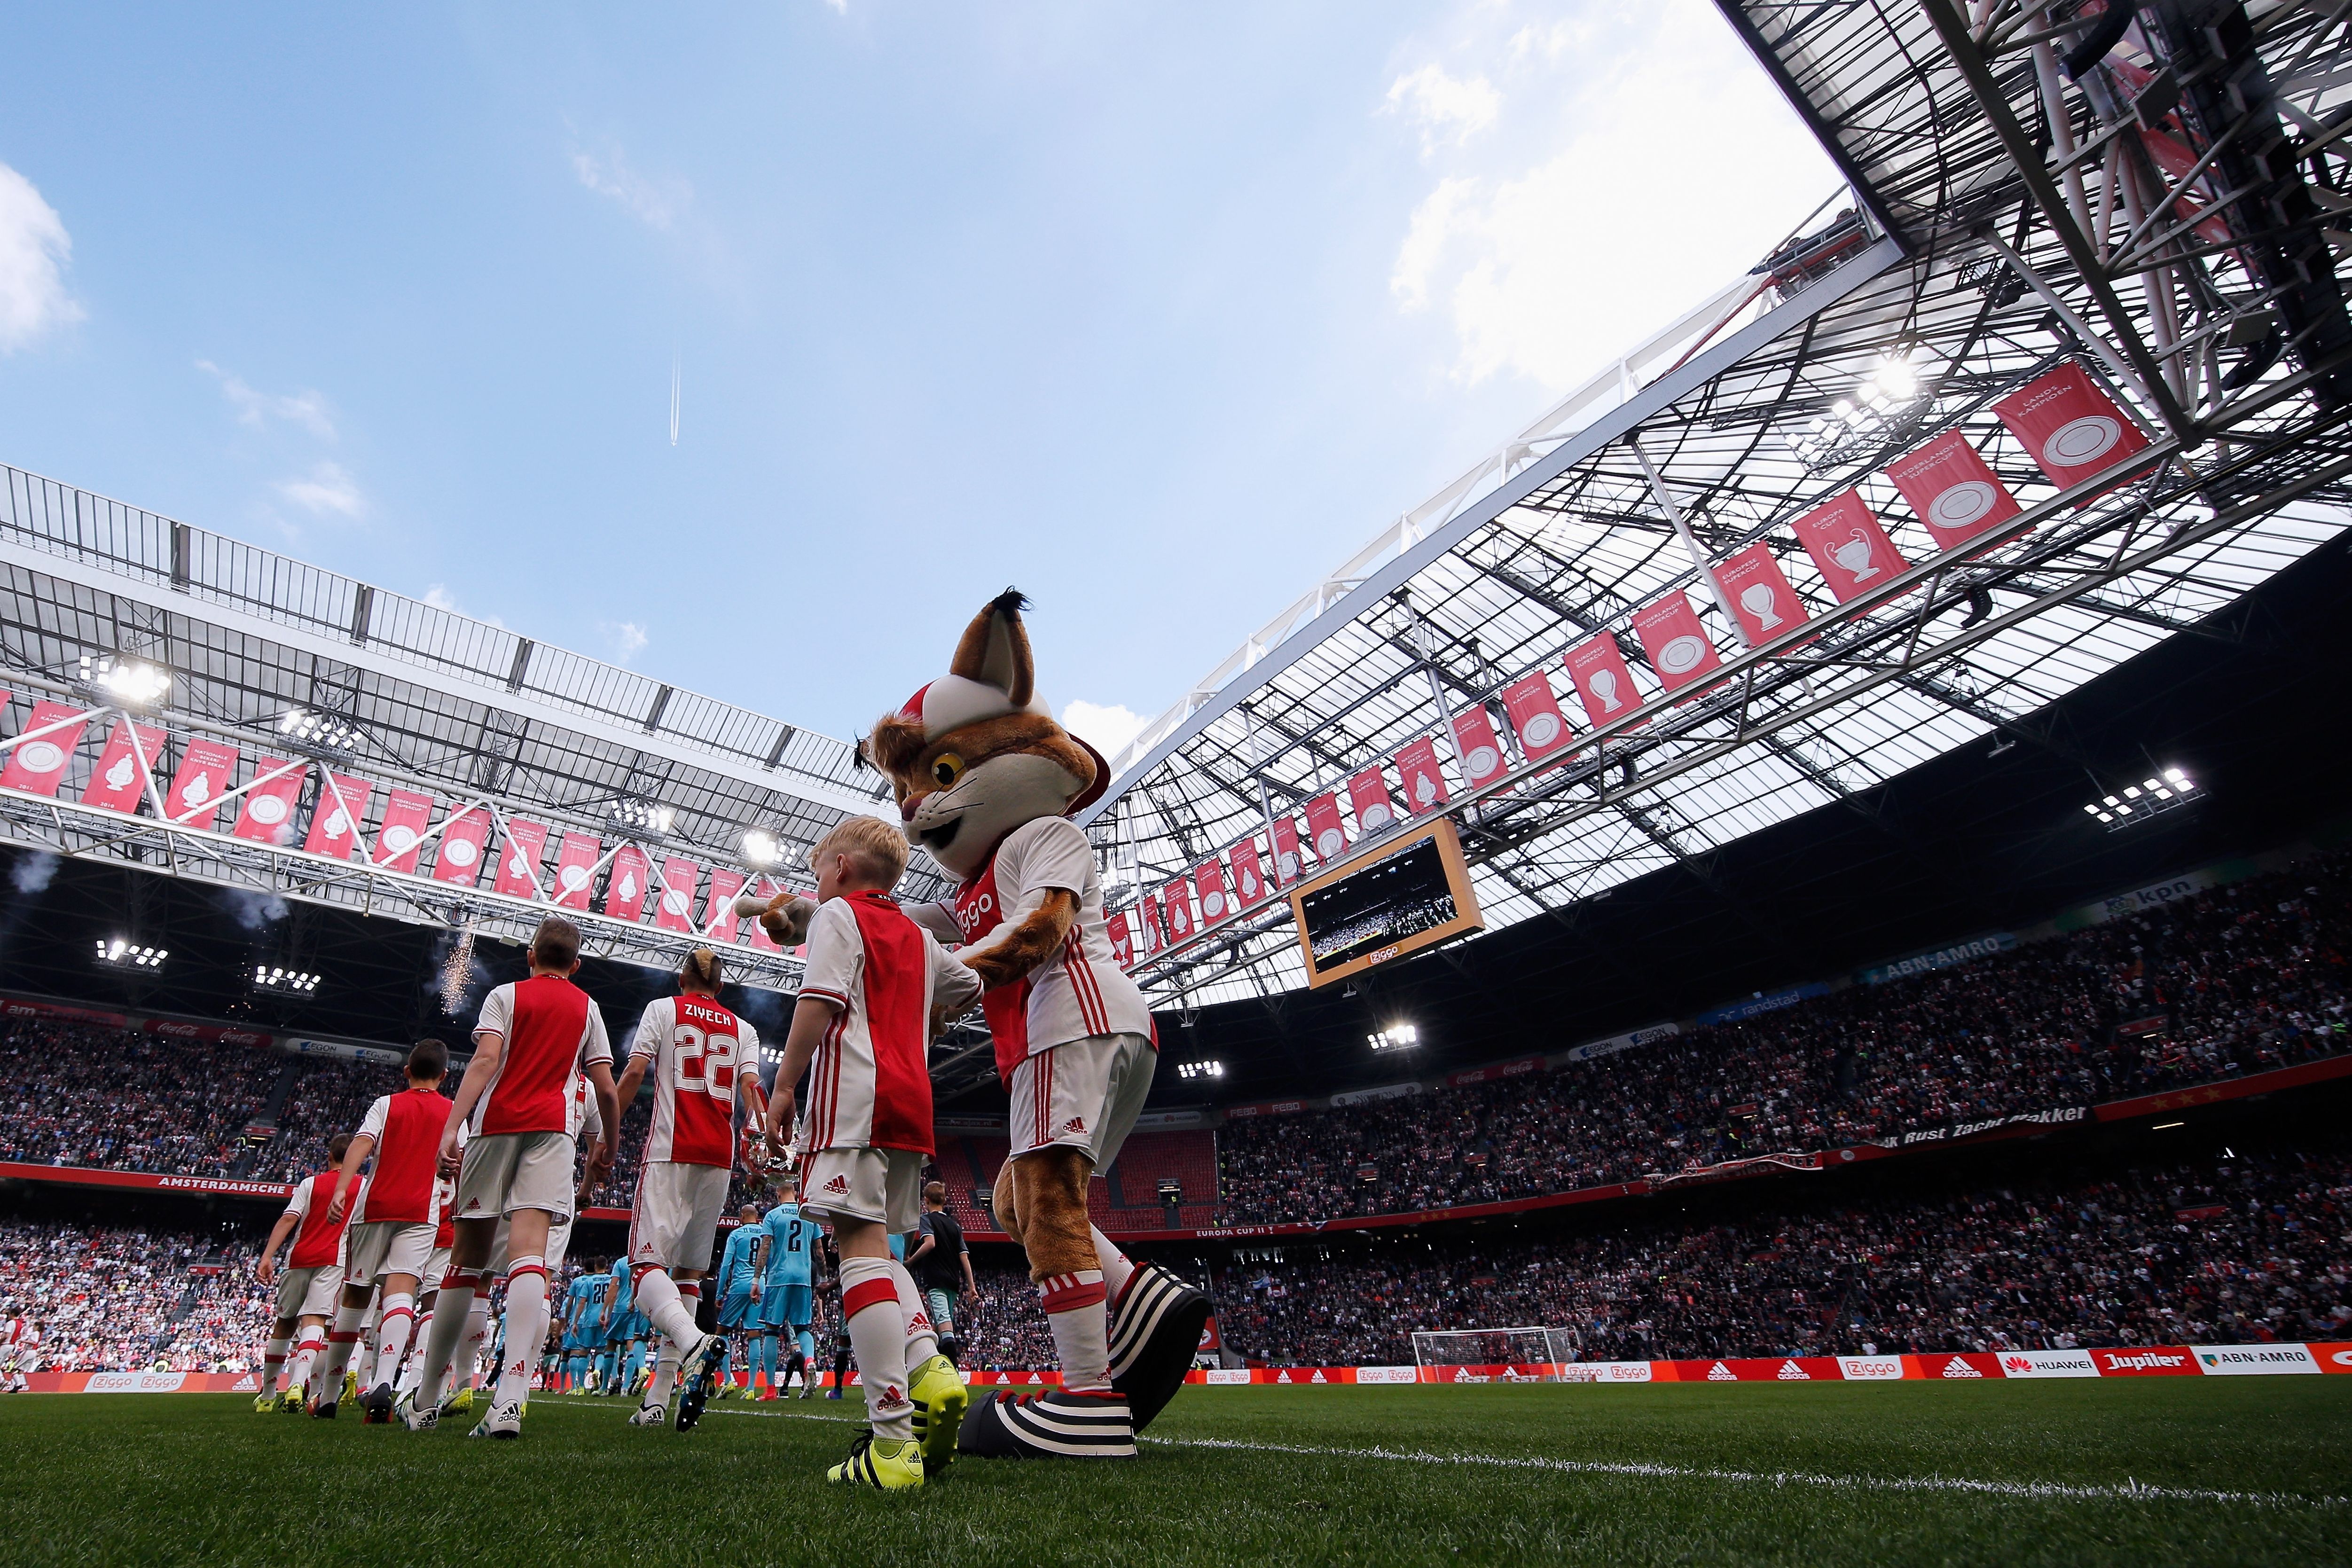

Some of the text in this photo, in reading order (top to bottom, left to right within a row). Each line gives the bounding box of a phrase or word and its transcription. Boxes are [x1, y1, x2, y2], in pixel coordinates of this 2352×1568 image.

[2018, 385, 2072, 417] KAMPIOEN
[2023, 385, 2058, 407] LANDS
[1896, 440, 1961, 480] NEDERLANDSE
[1908, 451, 1954, 480] SUPERCUP
[1812, 508, 1844, 527] EUROPA
[1820, 518, 1838, 530] CUP
[1722, 557, 1757, 580] EUROPESE
[1724, 562, 1760, 585] SUPERCUP
[1638, 599, 1684, 627] NEDERLANDSE
[1646, 608, 1679, 629] SUPERCUP
[1575, 645, 1603, 664] EUROPESE
[1576, 649, 1606, 669] SUPERCUP
[1513, 687, 1541, 705] KAMPIOEN
[1516, 685, 1534, 698] LANDS
[1458, 718, 1475, 730] LANDS
[194, 748, 227, 760] NATIONALE
[1401, 747, 1427, 763] NATIONALE
[337, 783, 362, 793] ATIONALE
[1358, 777, 1372, 787] LANDS
[392, 798, 427, 809] NEDERLANDSE
[397, 803, 422, 812] SUPERCUP
[514, 827, 540, 836] NATIONALE
[1276, 826, 1286, 835] ANDS
[621, 853, 644, 861] NATIONALE
[2137, 879, 2191, 904] kpn
[1742, 991, 1800, 1016] randstad
[684, 1004, 731, 1026] ZIYECH
[673, 1024, 740, 1102] 22
[1230, 1102, 1300, 1117] FEBO FEBO
[1063, 1125, 1087, 1134] adidas
[1904, 1127, 1946, 1144] Rust
[159, 1177, 285, 1194] AMSTERDAMSCHE
[823, 1184, 848, 1194] adidas
[717, 1218, 743, 1226] AND.
[788, 1220, 801, 1252] 2
[750, 1237, 760, 1265] 8
[2035, 1361, 2092, 1370] HUAWEI
[2103, 1352, 2185, 1371] Jupiler
[498, 1414, 519, 1422] adida
